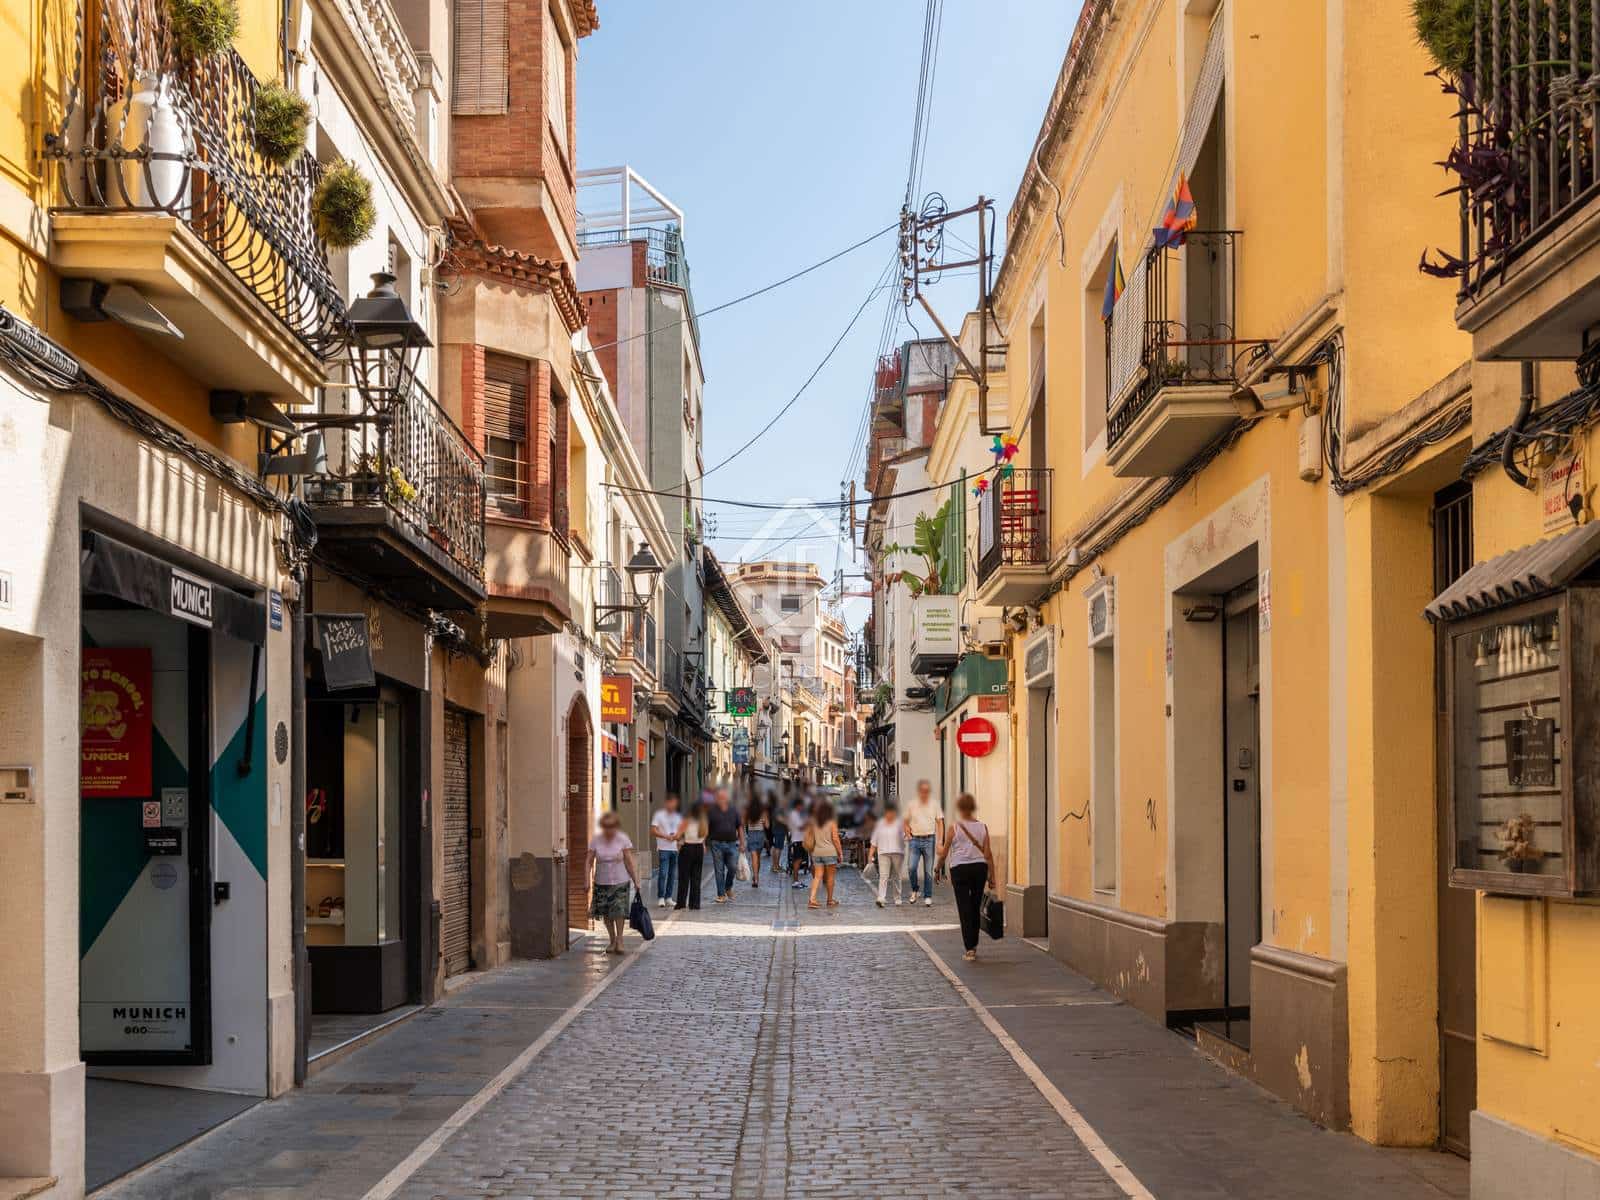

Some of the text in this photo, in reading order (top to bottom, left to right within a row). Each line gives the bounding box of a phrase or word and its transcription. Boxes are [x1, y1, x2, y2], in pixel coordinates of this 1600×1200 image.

[171, 577, 212, 617] MUNICH
[323, 627, 355, 661] paso
[102, 670, 144, 710] SCHOOL
[602, 706, 627, 715] BACS
[82, 751, 129, 761] UNICH
[113, 1007, 186, 1019] MUNICH
